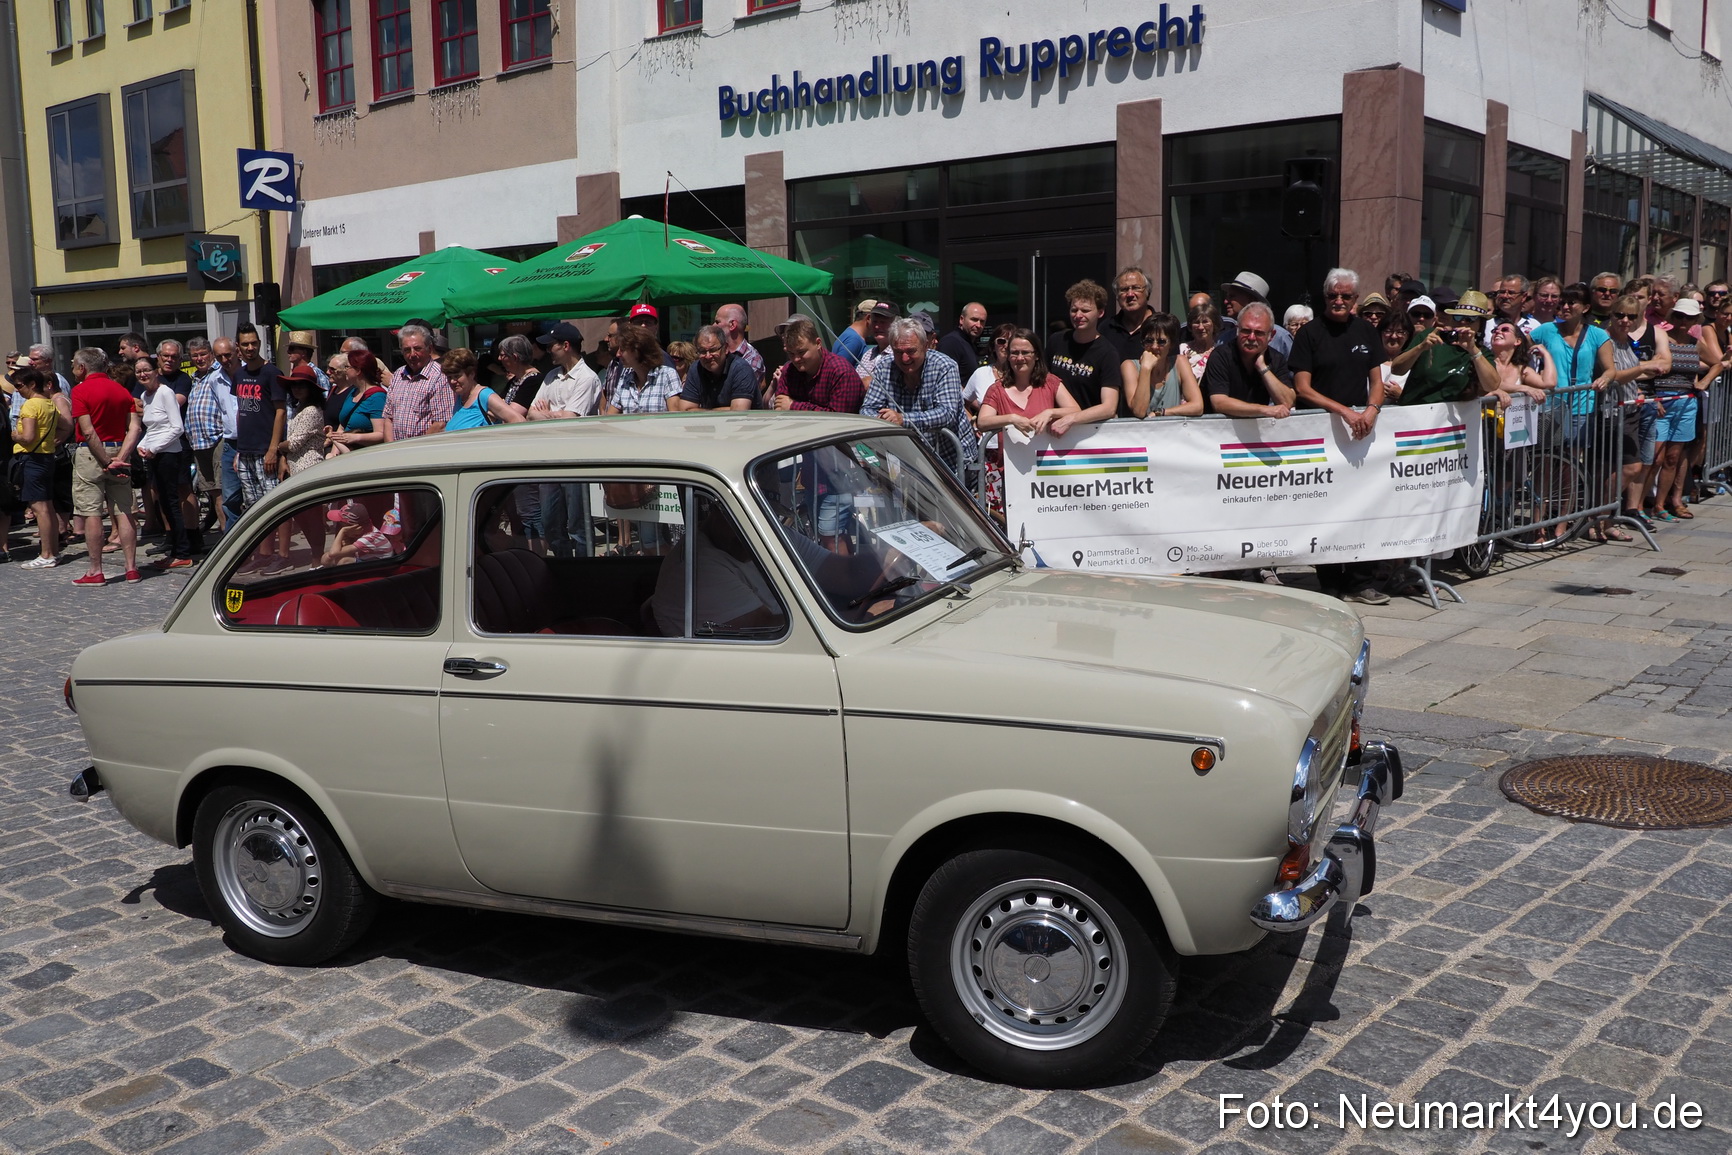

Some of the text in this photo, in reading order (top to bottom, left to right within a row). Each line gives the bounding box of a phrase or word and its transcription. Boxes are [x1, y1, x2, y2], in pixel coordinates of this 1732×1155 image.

[719, 3, 1206, 121] Buchhandlung Rupprecht
[303, 224, 346, 239] Unterer Markt 15
[210, 249, 228, 273] G2
[1390, 453, 1469, 479] NeuerMarkt
[1216, 467, 1334, 490] NeuerMarkt
[1030, 477, 1154, 499] NeuerMarkt
[1395, 482, 1429, 492] einkaufen
[1432, 480, 1445, 488] leben
[1222, 490, 1328, 504] einkaufen leben genießen
[1037, 500, 1150, 513] einkaufen leben genießen
[1256, 539, 1288, 549] über 500
[1320, 542, 1366, 553] NM-Neumarkt
[1087, 547, 1135, 558] Dammstraße
[1210, 553, 1224, 561] Uhr
[1087, 558, 1124, 567] Neumarkt
